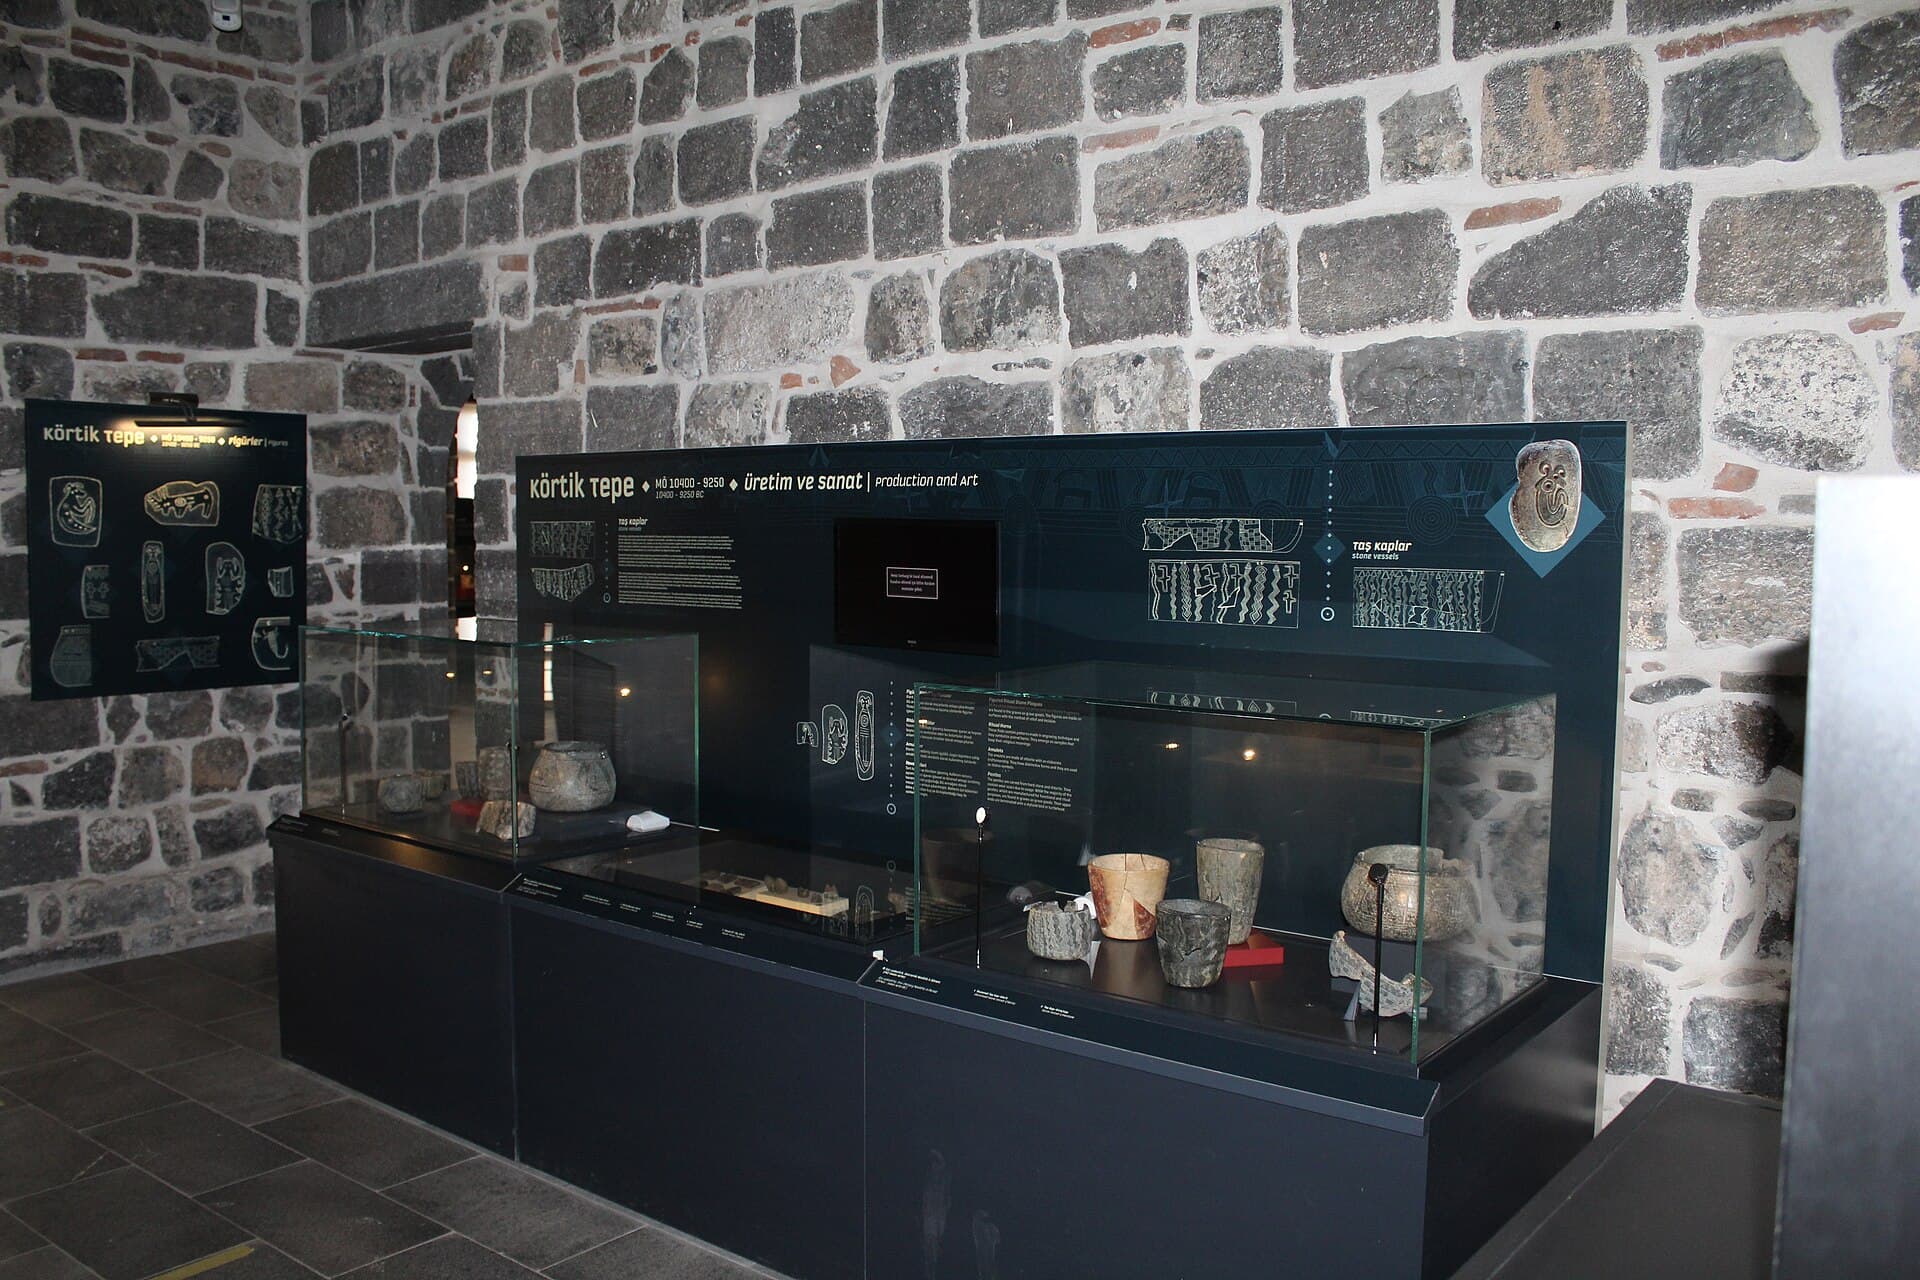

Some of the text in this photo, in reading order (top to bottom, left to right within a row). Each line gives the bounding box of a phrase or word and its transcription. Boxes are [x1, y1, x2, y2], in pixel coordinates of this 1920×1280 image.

[43, 423, 100, 443] Körtik
[103, 429, 145, 448] Tepe
[669, 477, 695, 489] 10400
[703, 477, 725, 488] 9250
[797, 475, 815, 490] ve
[936, 472, 958, 487] and
[960, 473, 979, 487] Art
[530, 471, 635, 504] Körtik Tepe
[1351, 552, 1400, 561] stone vessels
